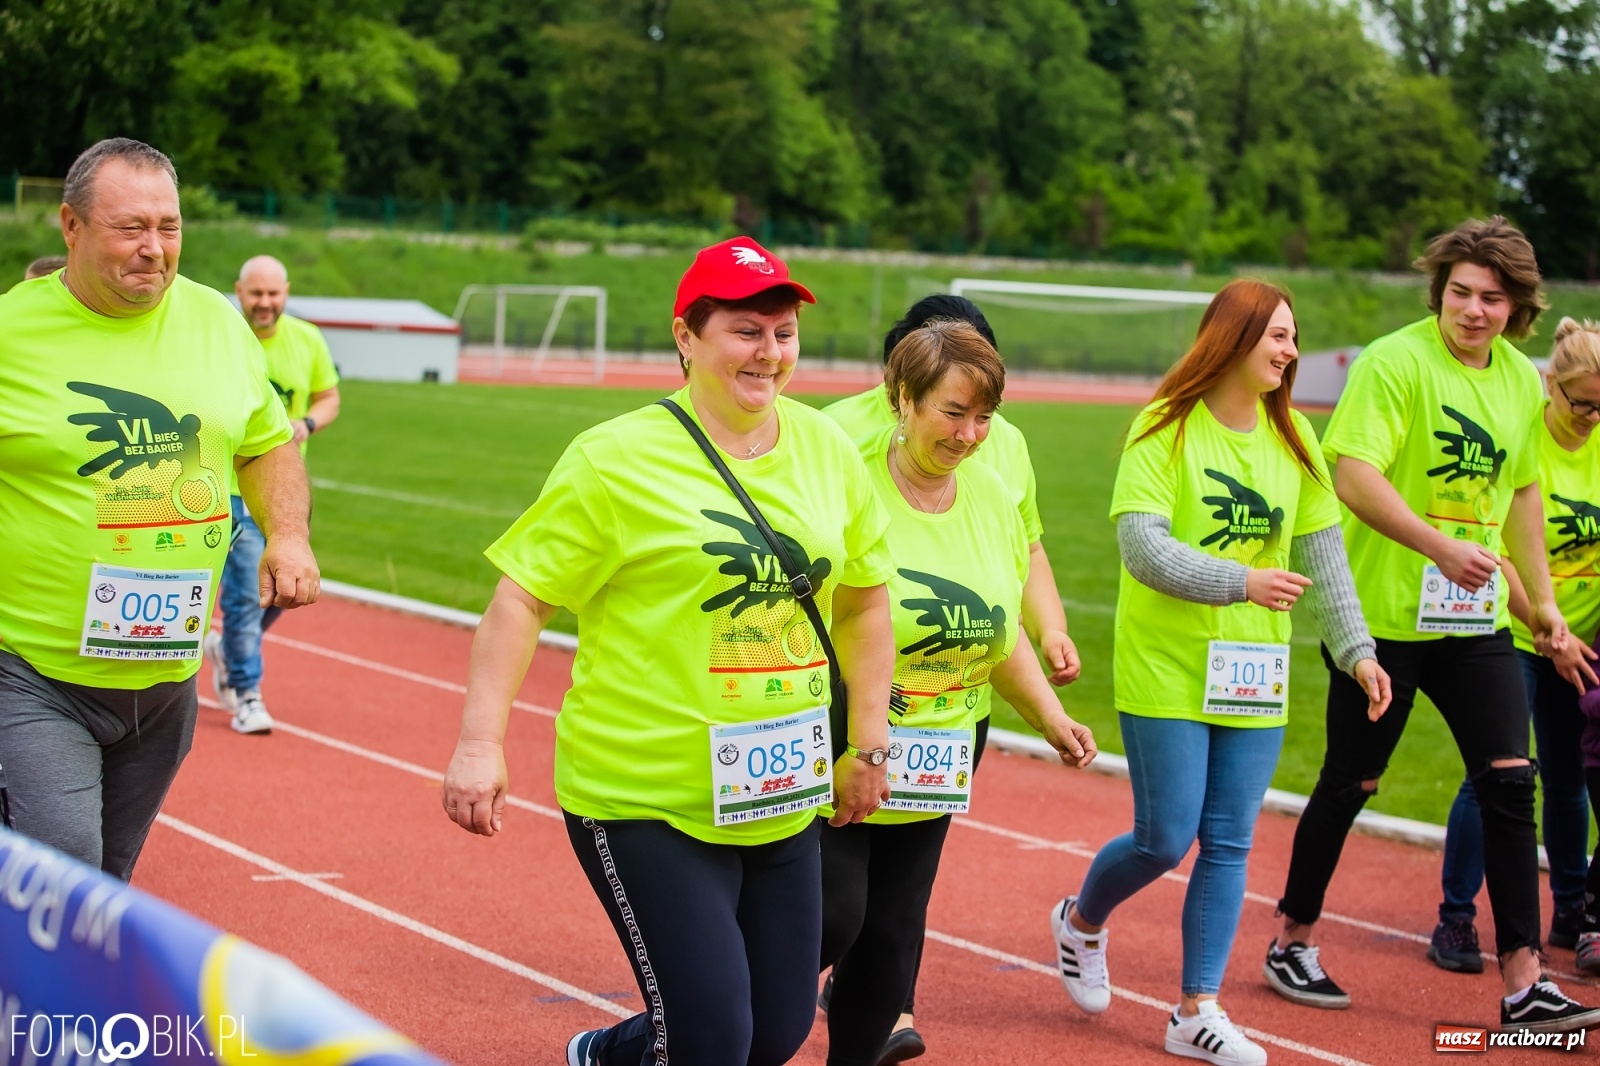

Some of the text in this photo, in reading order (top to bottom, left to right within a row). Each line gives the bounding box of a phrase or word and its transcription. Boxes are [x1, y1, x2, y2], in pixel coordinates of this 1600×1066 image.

[117, 418, 180, 445] VI BIEG
[124, 442, 185, 456] BEZ BARIER
[1463, 440, 1482, 463] VI
[1231, 503, 1270, 526] VI BIEG
[1575, 516, 1597, 537] VI
[1229, 525, 1271, 534] BEZ BARIER
[750, 553, 781, 583] VI
[190, 585, 203, 601] R
[749, 582, 792, 592] BEZ BAR
[121, 592, 181, 622] 005
[941, 605, 992, 629] VI BIEG
[945, 629, 995, 639] BEZ BARIER
[1230, 662, 1267, 685] 101
[1275, 658, 1283, 670] R
[813, 724, 824, 742] R
[747, 738, 806, 778] 085
[907, 743, 953, 772] 084
[960, 745, 968, 760] R
[600, 847, 614, 876] NICE
[610, 877, 626, 904] NICE
[622, 906, 638, 933] NICE
[633, 935, 647, 962] NICE
[642, 964, 657, 992] NICE
[653, 994, 662, 1022] NICE
[656, 1024, 665, 1051] NICE
